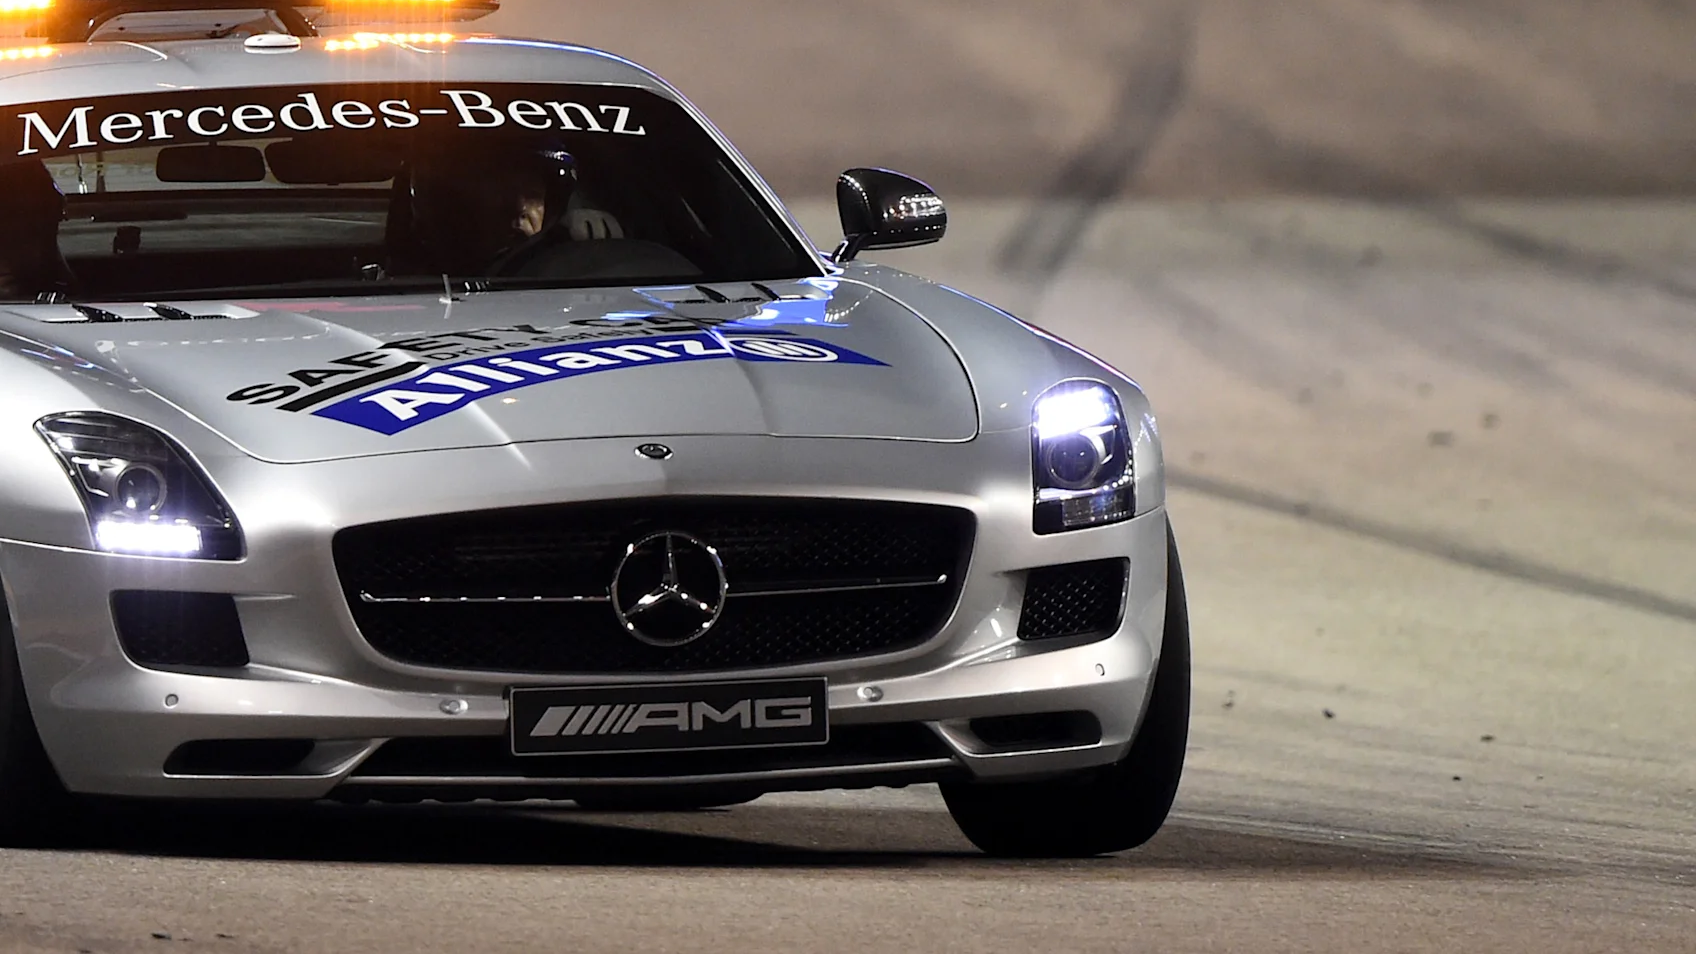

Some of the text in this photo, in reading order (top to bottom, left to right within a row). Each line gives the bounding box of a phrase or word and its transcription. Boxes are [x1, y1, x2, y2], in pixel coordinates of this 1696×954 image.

[17, 89, 645, 156] Mercedes-Benz
[225, 325, 550, 404] SAFETY
[359, 337, 730, 421] Allianz
[422, 341, 531, 361] Drive
[621, 696, 813, 734] AMG
